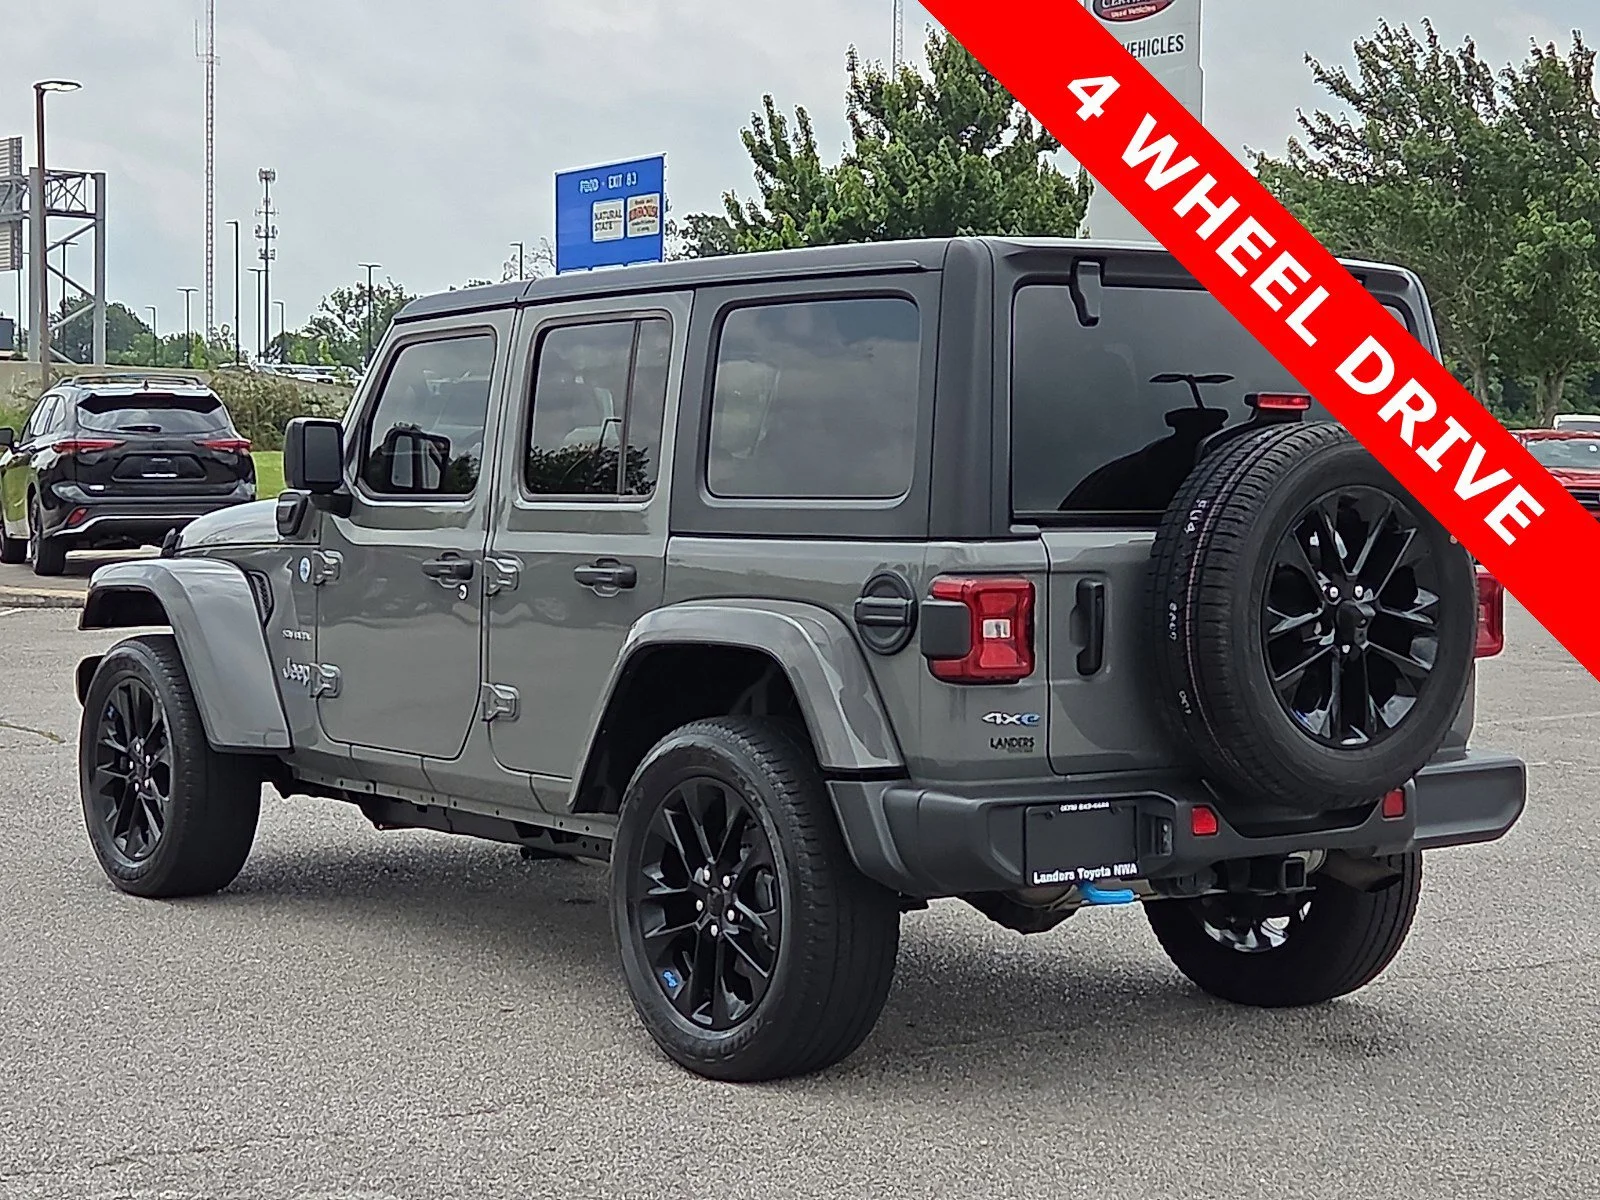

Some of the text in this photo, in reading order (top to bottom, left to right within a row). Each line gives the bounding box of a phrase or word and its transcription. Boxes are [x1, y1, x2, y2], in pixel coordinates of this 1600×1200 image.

[282, 657, 310, 686] Jeep
[990, 736, 1035, 750] LANDERS
[1033, 863, 1138, 884] Landers Toyota NWA
